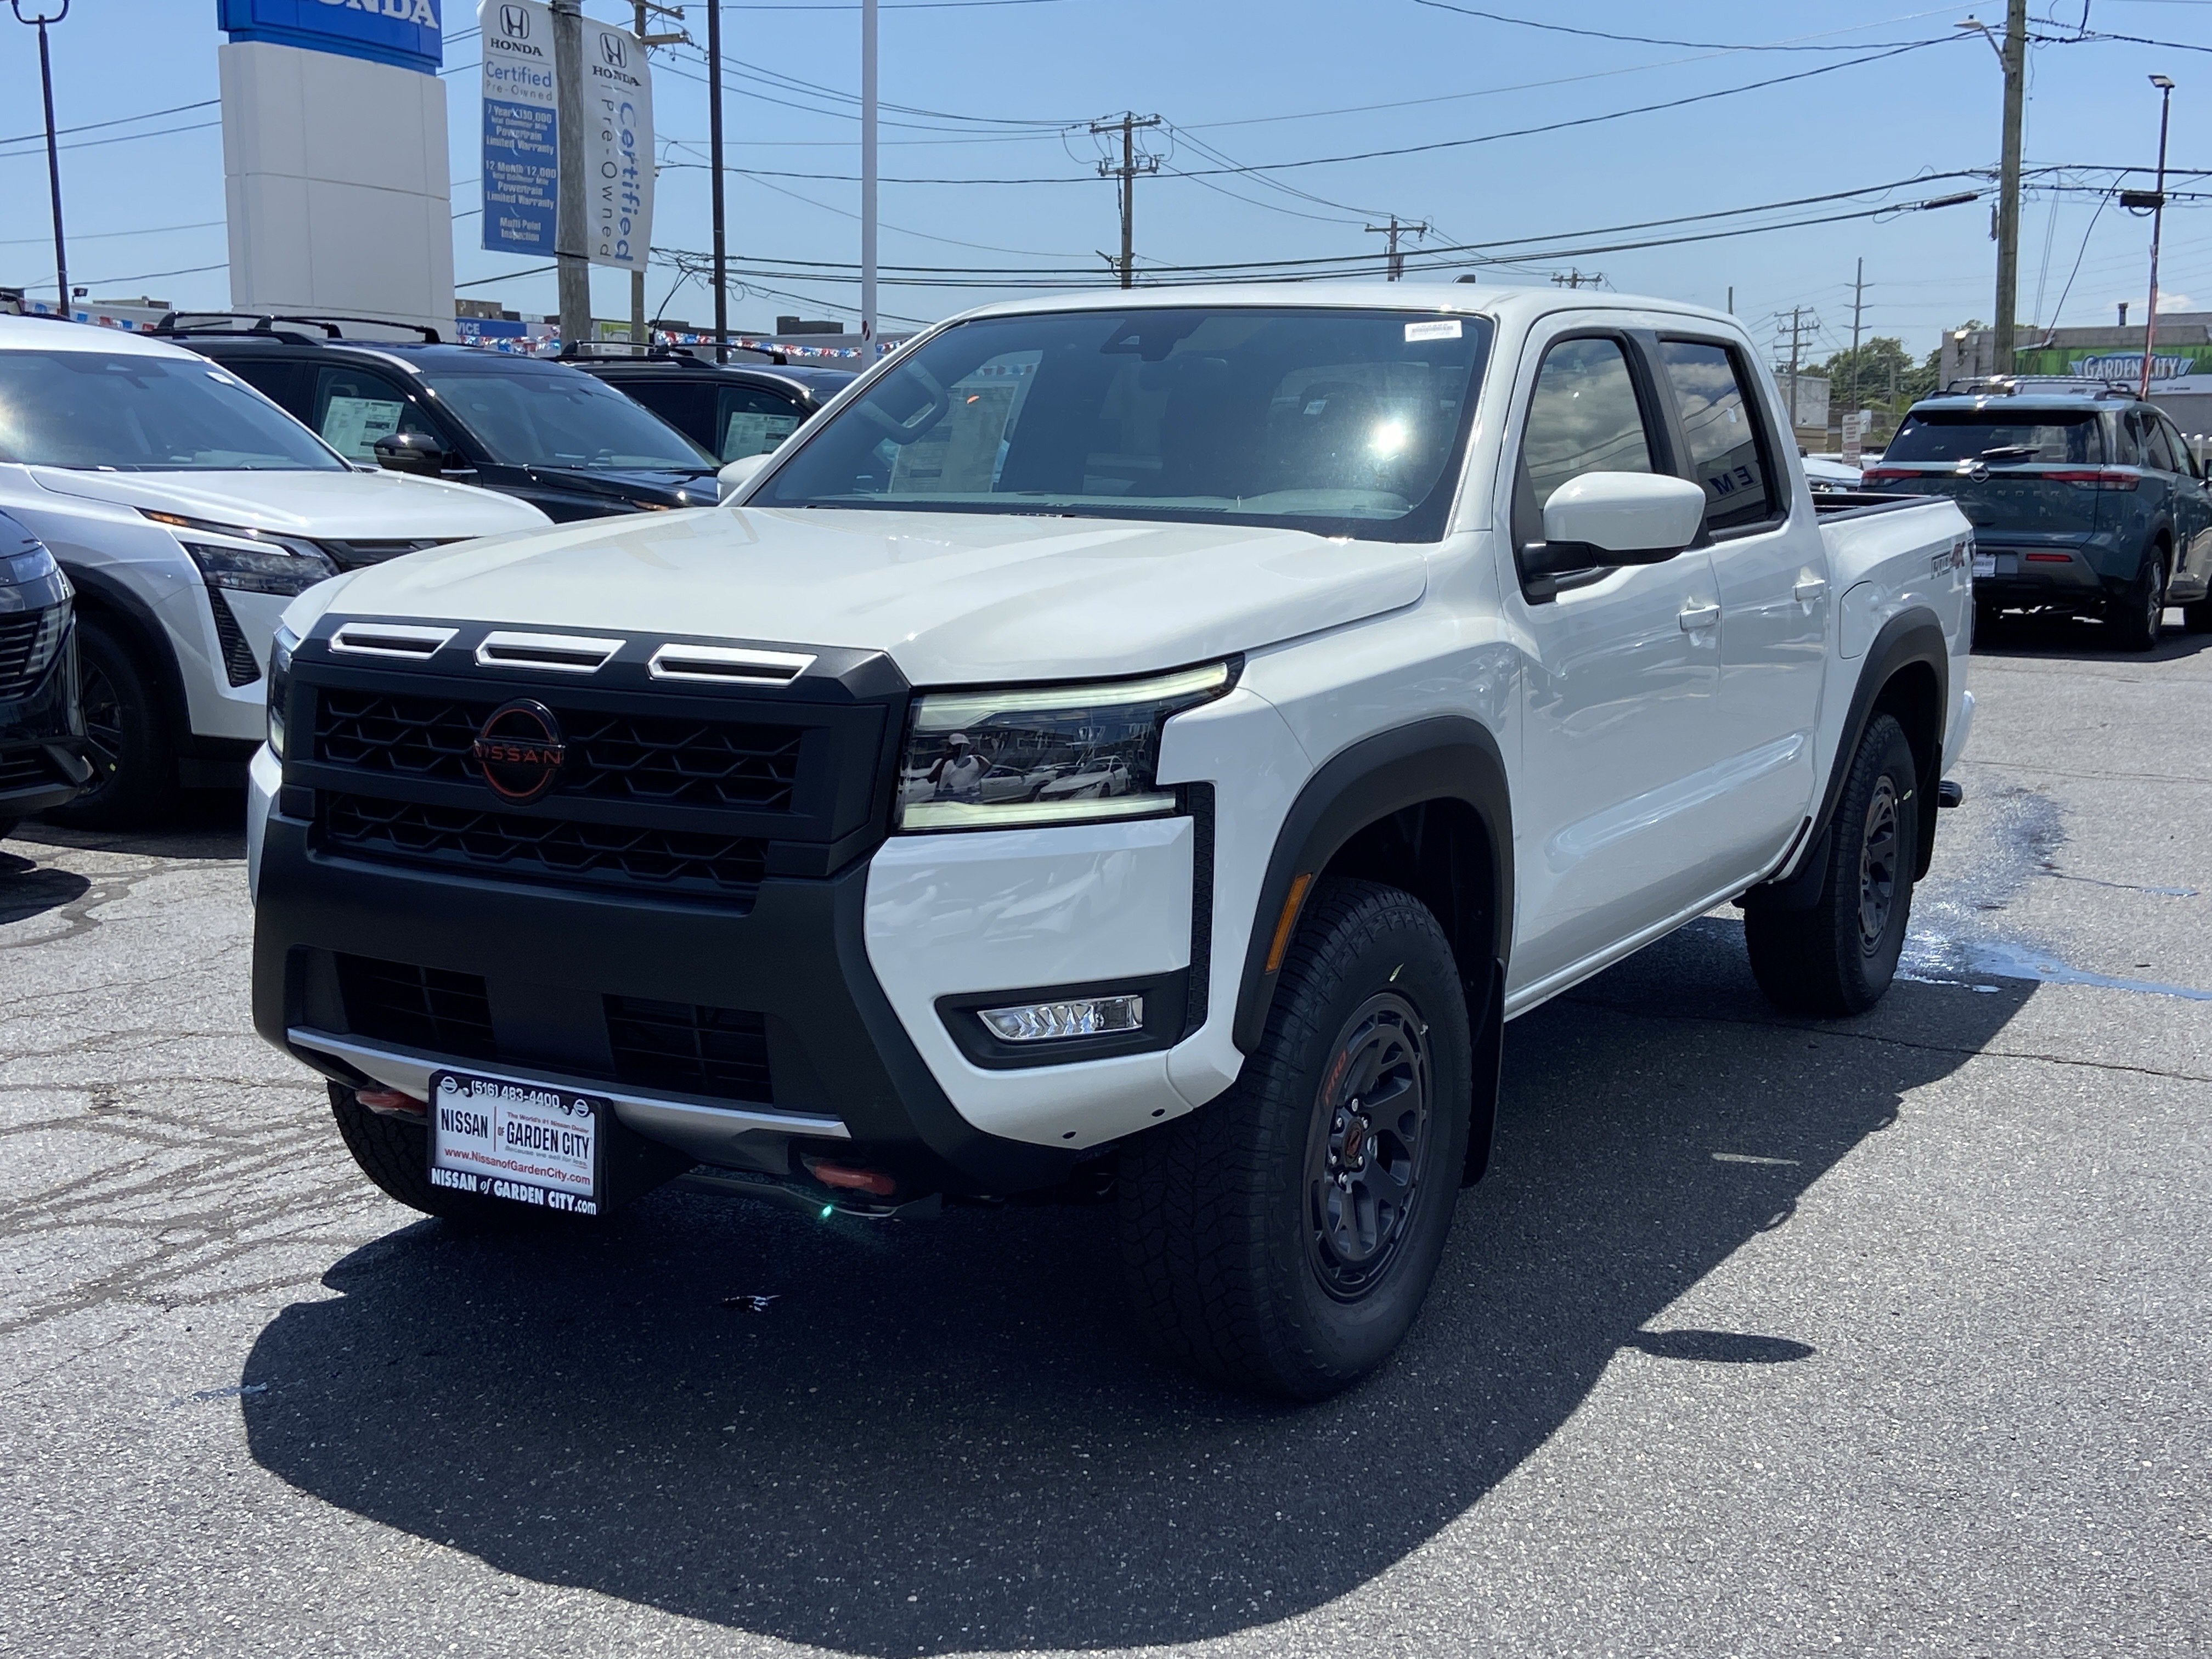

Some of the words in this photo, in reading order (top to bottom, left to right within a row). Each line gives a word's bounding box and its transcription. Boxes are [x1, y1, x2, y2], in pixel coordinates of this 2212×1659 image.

[490, 38, 543, 57] HONDA
[486, 60, 552, 88] Certified
[592, 65, 642, 87] HONDA
[486, 80, 552, 101] Pre-Owned
[600, 99, 618, 257] Pre-Owned
[614, 101, 641, 262] Certified
[2085, 358, 2139, 379] GARDEN
[473, 744, 562, 765] NISSAN
[471, 1080, 498, 1096] (516)
[501, 1086, 560, 1109] 483-4400
[441, 1108, 488, 1139] NISSAN
[507, 1121, 558, 1153] GARDEN
[562, 1132, 589, 1159] CITY
[444, 1148, 590, 1186] www.NissanofGardenCity.com
[431, 1167, 477, 1192] NISSAN
[480, 1177, 493, 1195] of
[494, 1180, 544, 1205] GARDEN
[548, 1191, 597, 1215] CITY.com
